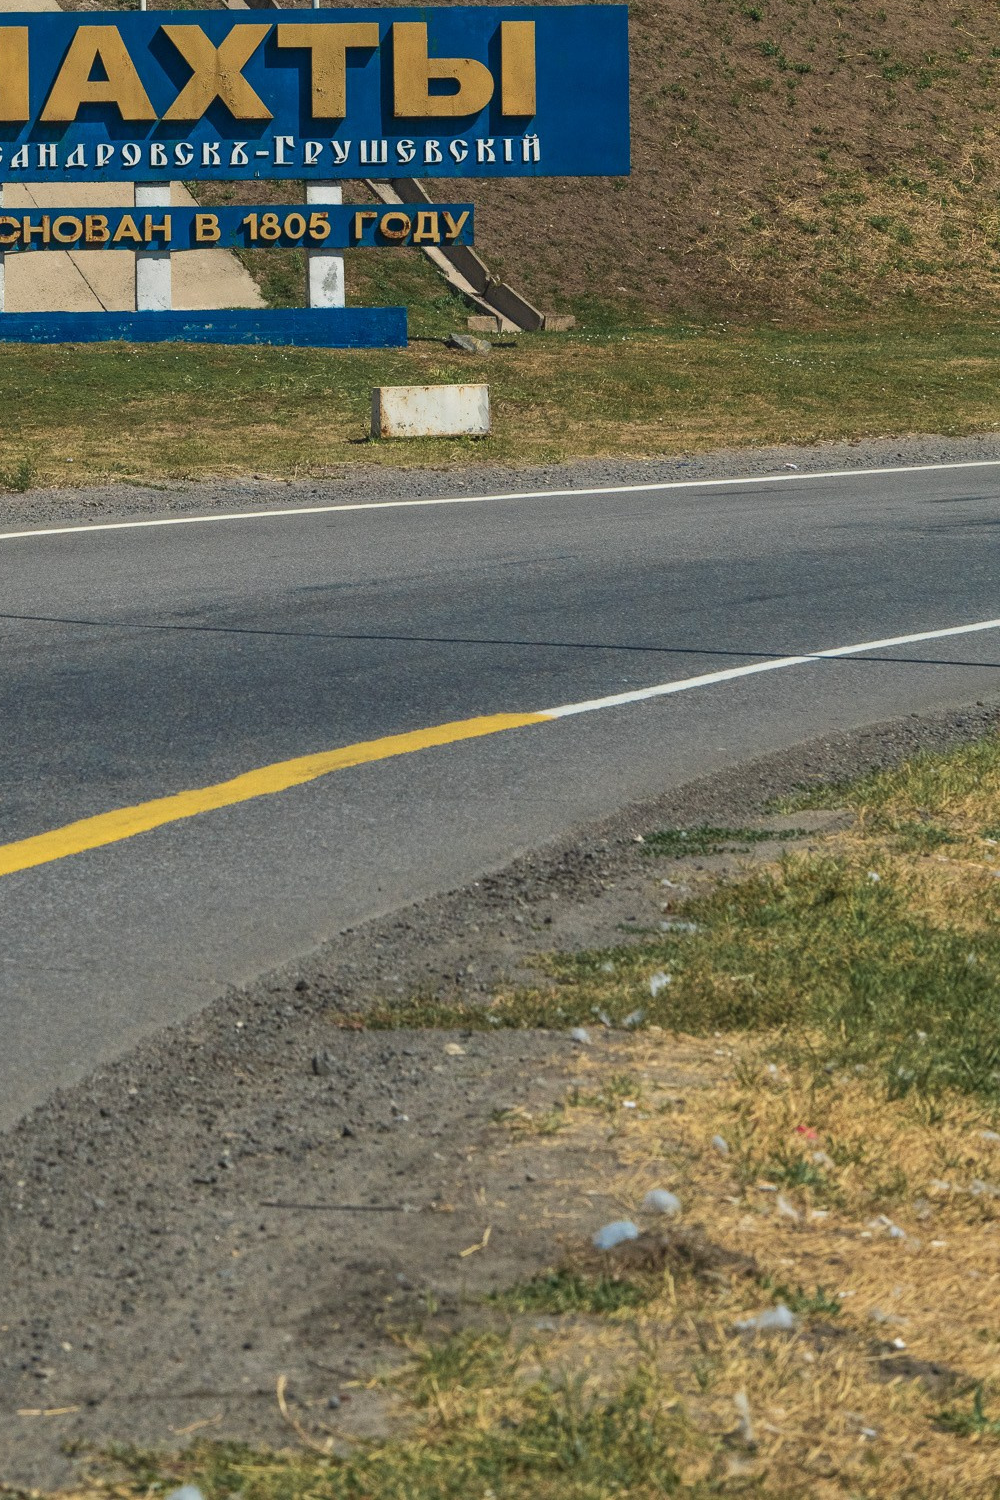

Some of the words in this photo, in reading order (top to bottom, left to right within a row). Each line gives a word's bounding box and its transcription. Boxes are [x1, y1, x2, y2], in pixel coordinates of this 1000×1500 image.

[195, 213, 222, 242] В
[242, 211, 332, 241] 1805
[354, 210, 471, 243] ГОДУ
